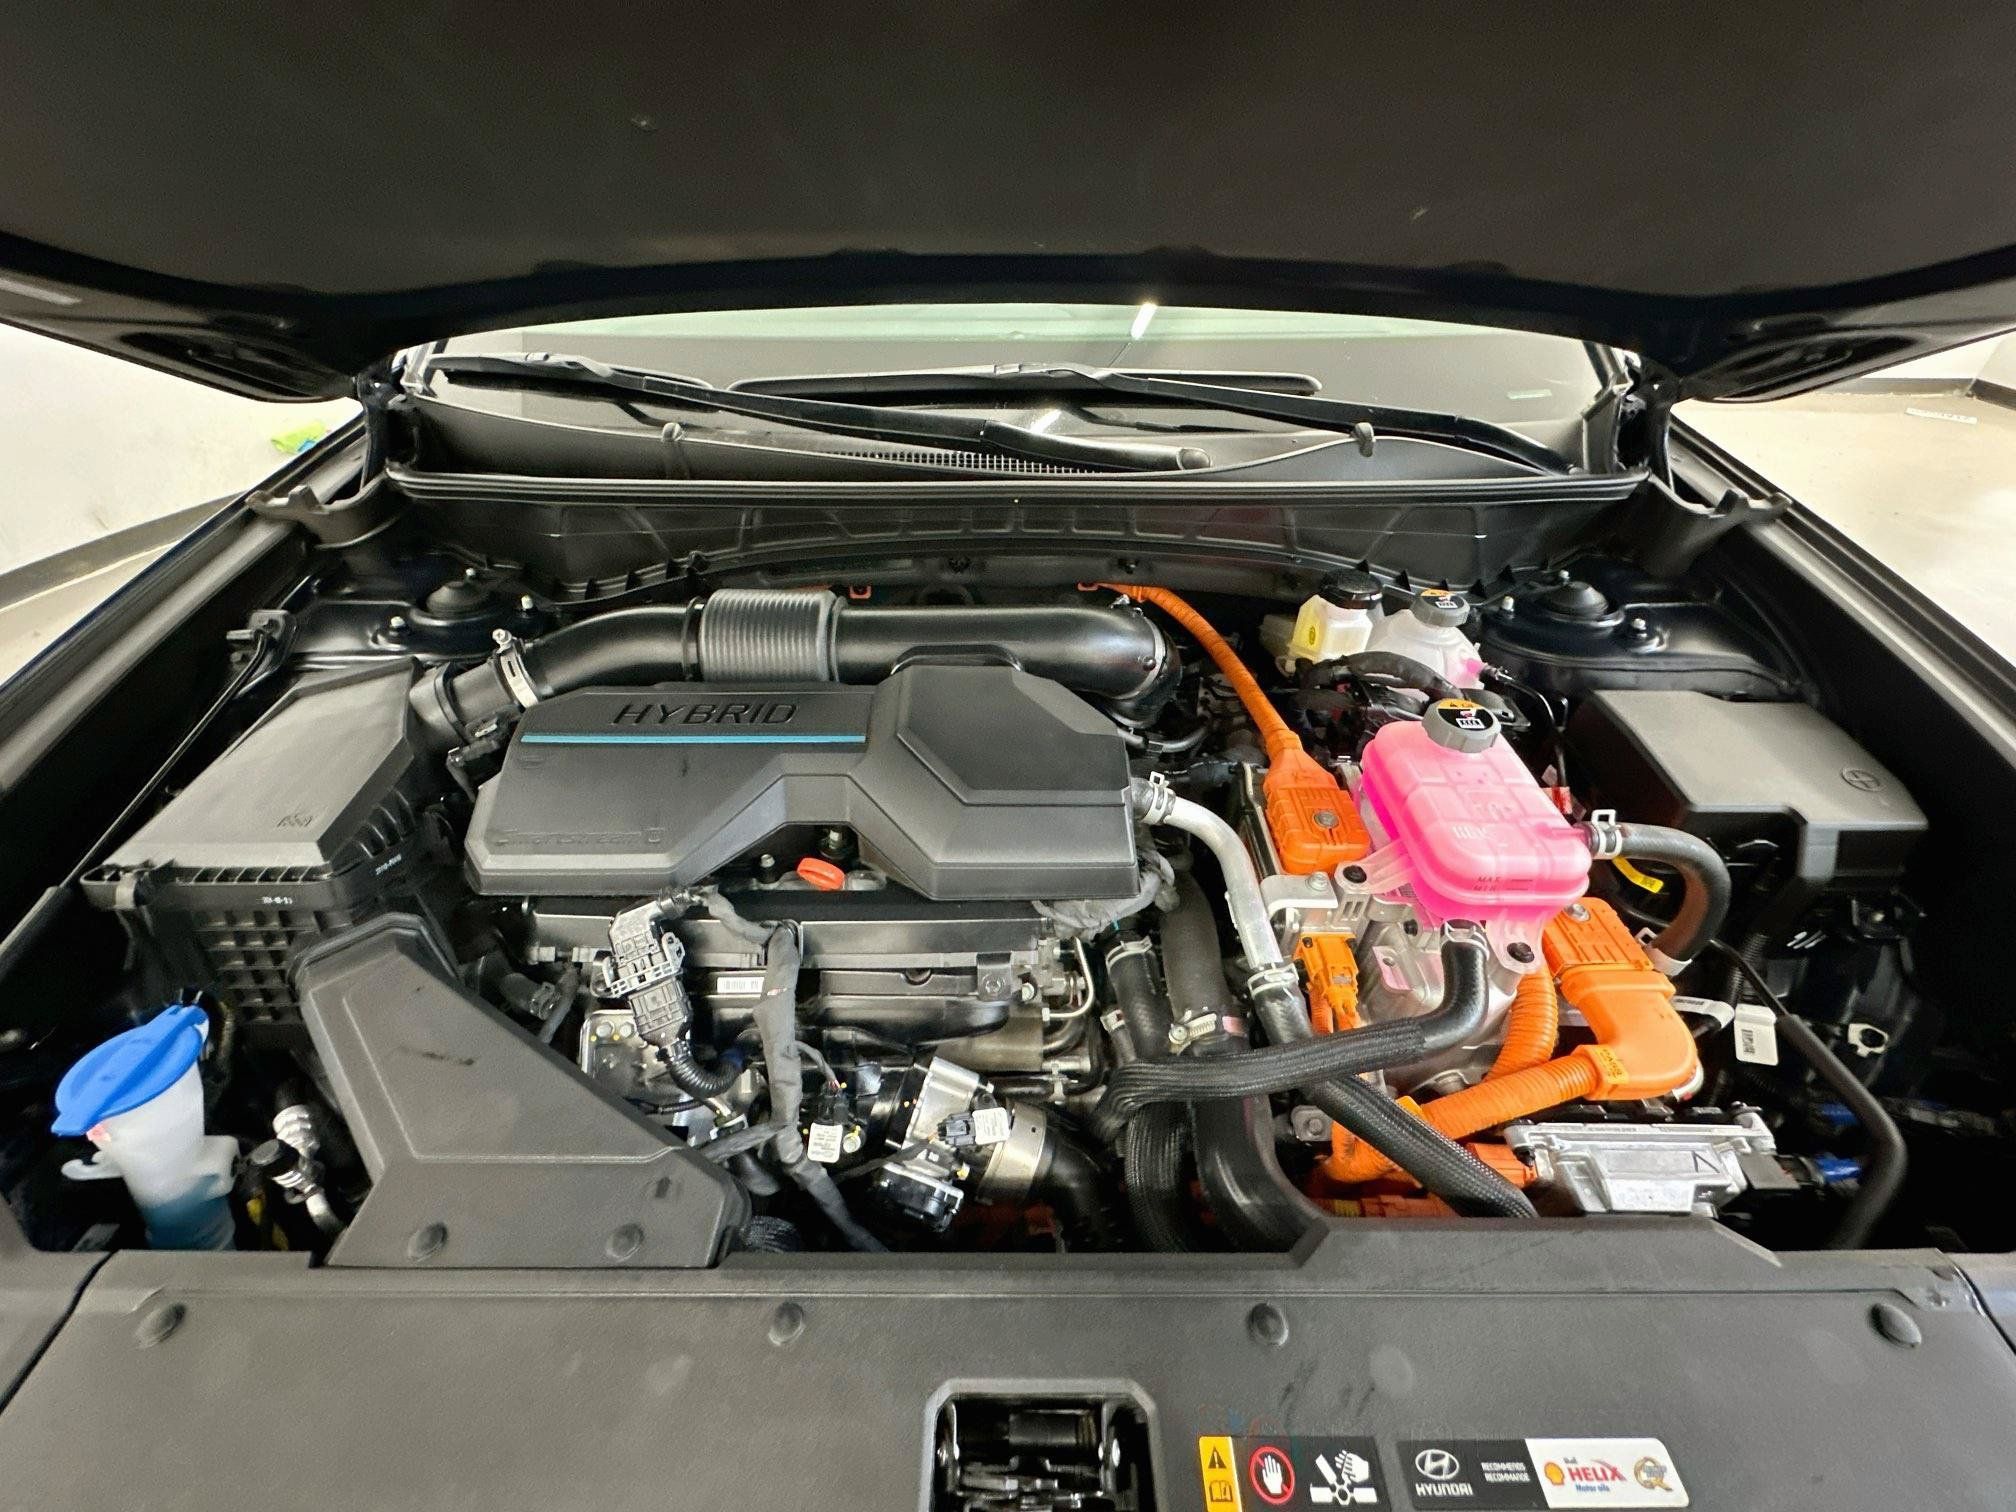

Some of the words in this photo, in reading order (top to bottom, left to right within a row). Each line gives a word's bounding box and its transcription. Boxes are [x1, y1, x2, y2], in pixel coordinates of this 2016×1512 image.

[611, 704, 799, 724] HYBRID
[1568, 1466, 1625, 1481] HELIX
[1415, 1483, 1474, 1497] HYUNDAI
